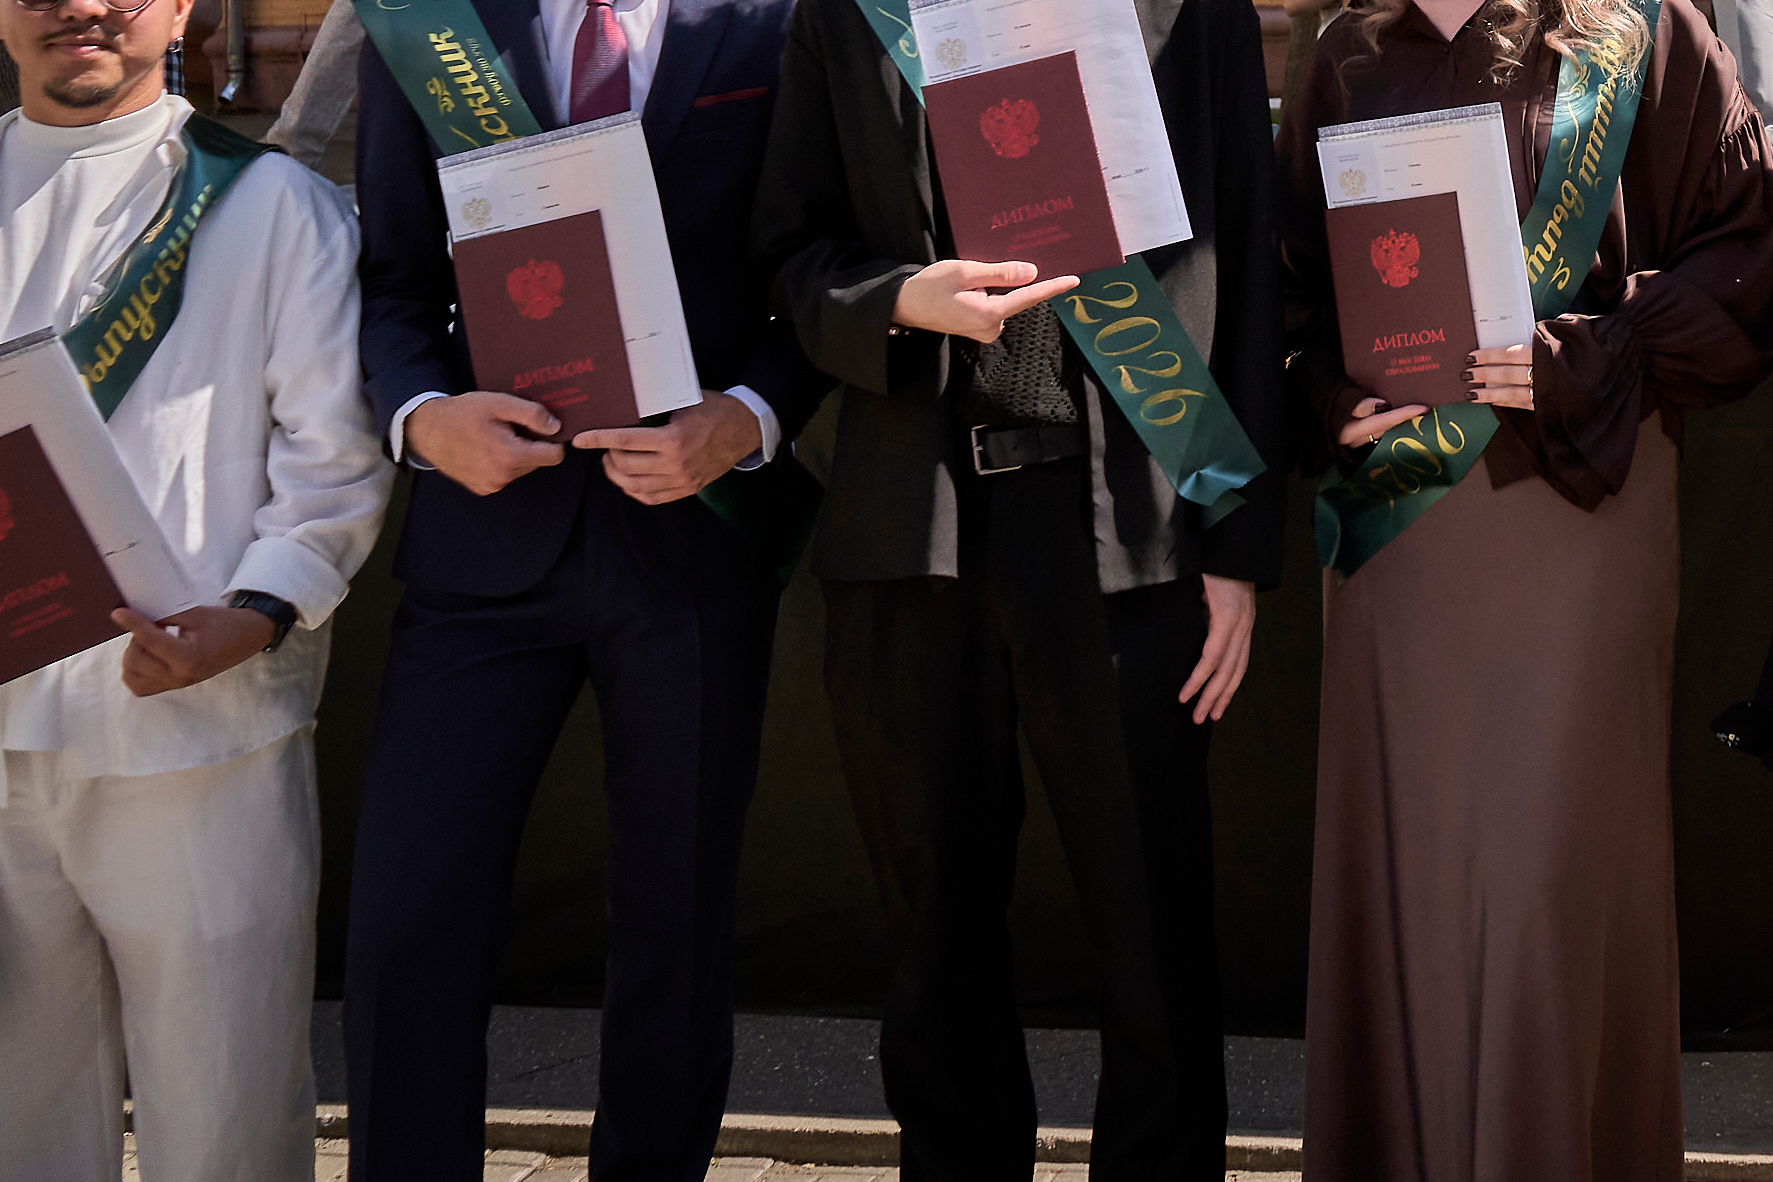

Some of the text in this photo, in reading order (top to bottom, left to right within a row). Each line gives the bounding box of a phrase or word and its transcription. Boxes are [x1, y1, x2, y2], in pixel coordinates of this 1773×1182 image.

[428, 26, 518, 142] скник
[991, 195, 1075, 230] ДИПЛОМ
[1065, 281, 1207, 427] 2026
[1373, 328, 1446, 353] ДИПЛОМ
